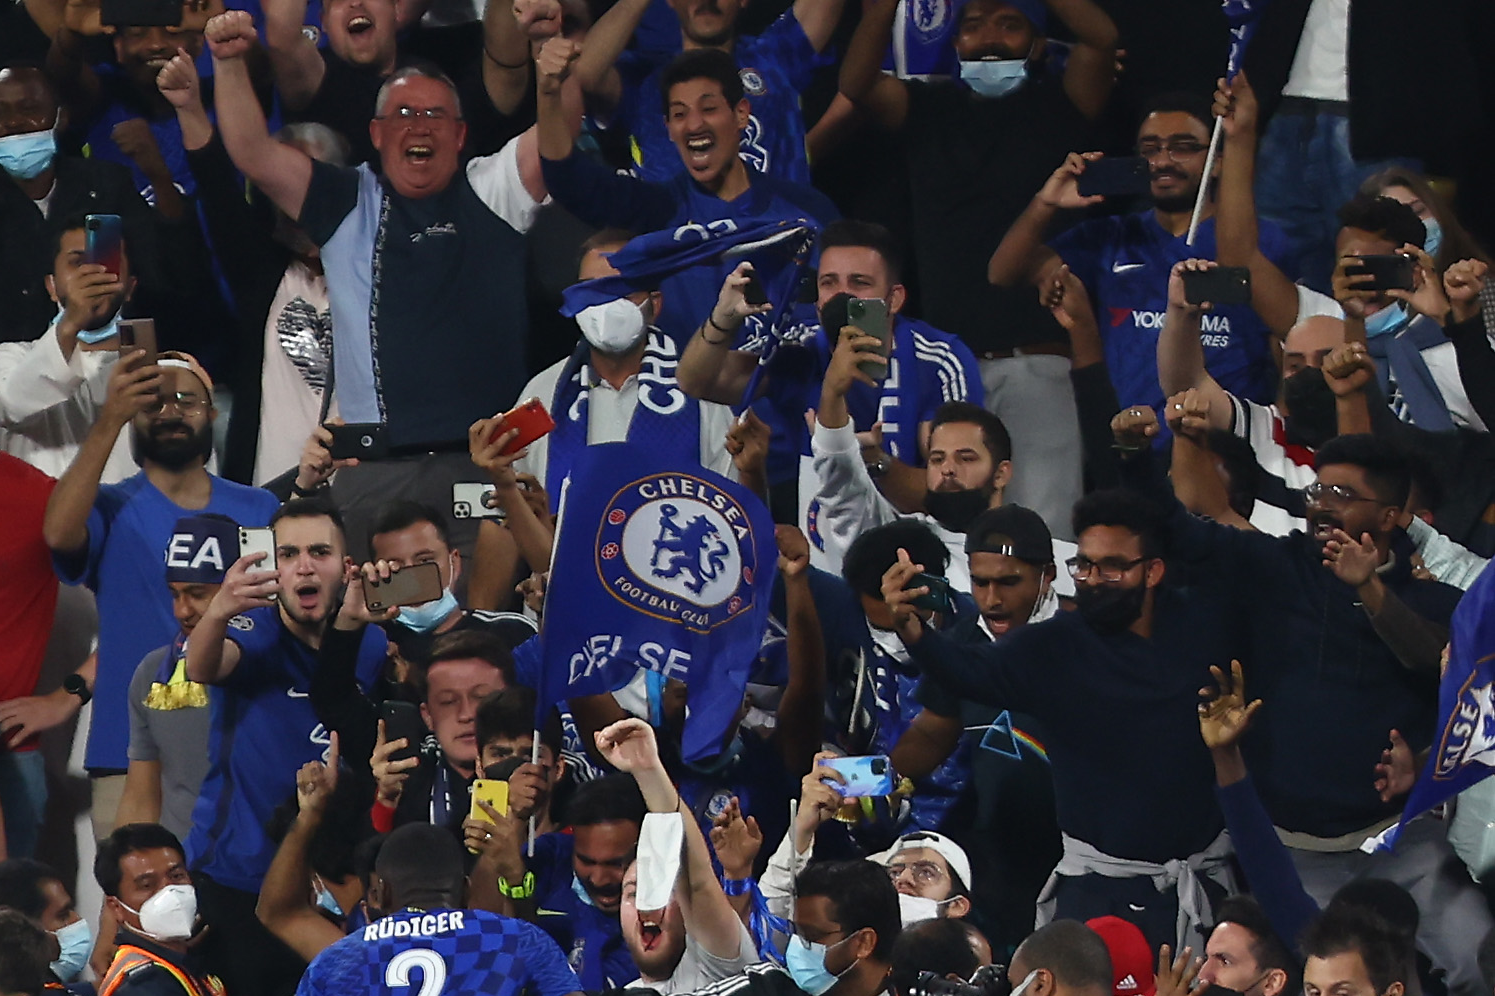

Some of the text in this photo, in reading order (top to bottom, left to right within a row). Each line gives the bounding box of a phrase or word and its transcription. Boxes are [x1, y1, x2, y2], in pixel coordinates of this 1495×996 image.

[1132, 310, 1230, 333] YOKMA
[639, 478, 749, 540] CHELSEA
[165, 533, 224, 570] EA
[364, 911, 464, 941] RÜDIGER
